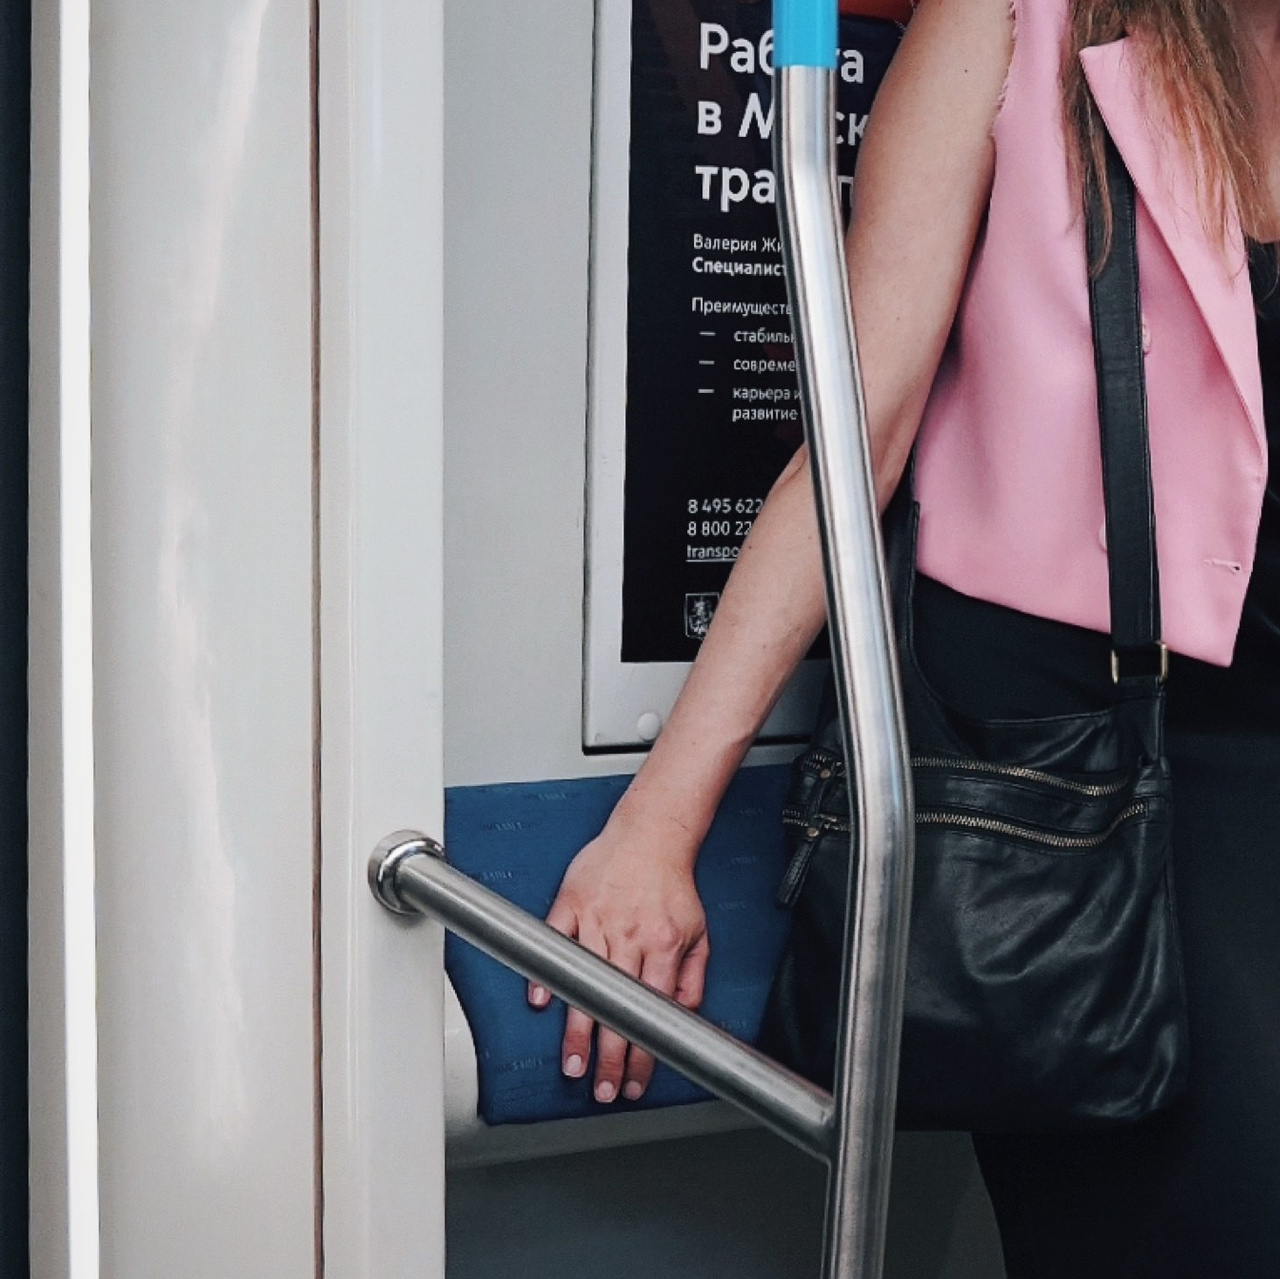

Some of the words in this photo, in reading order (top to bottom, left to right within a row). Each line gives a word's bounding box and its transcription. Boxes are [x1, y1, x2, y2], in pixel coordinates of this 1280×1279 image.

[697, 100, 722, 136] в
[693, 233, 757, 254] Валерия
[732, 387, 791, 403] карьера
[732, 408, 799, 422] развитие
[687, 499, 699, 514] 8
[701, 498, 732, 514] 495
[687, 521, 697, 536] 8
[702, 521, 731, 536] 800
